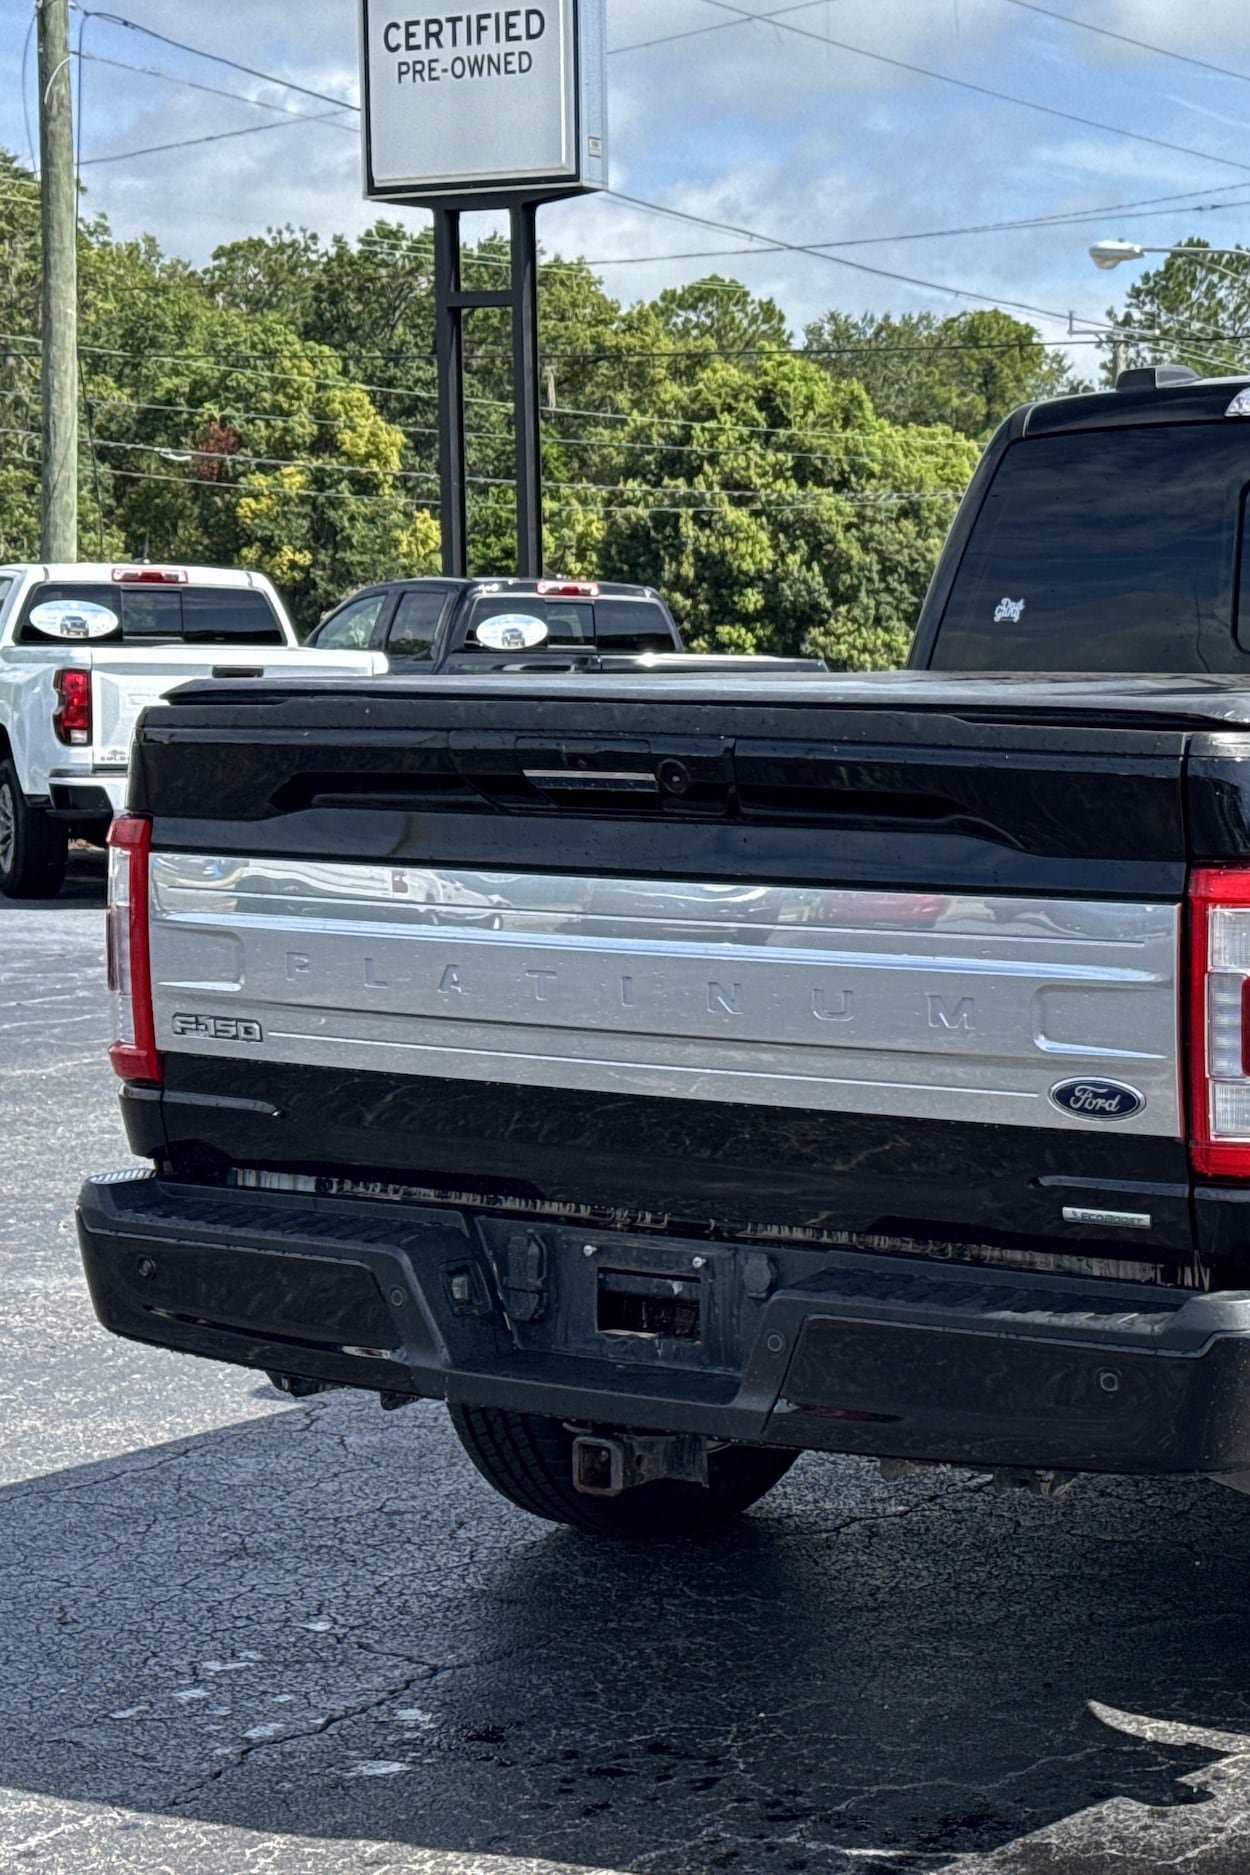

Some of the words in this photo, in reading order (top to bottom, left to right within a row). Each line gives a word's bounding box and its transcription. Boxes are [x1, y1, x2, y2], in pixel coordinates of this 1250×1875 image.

[383, 8, 545, 53] CERTIFIED
[397, 51, 533, 84] PRE-OWNED
[285, 950, 976, 1031] PLATINUM
[172, 1012, 264, 1042] F-150
[1069, 1085, 1121, 1112] Ford
